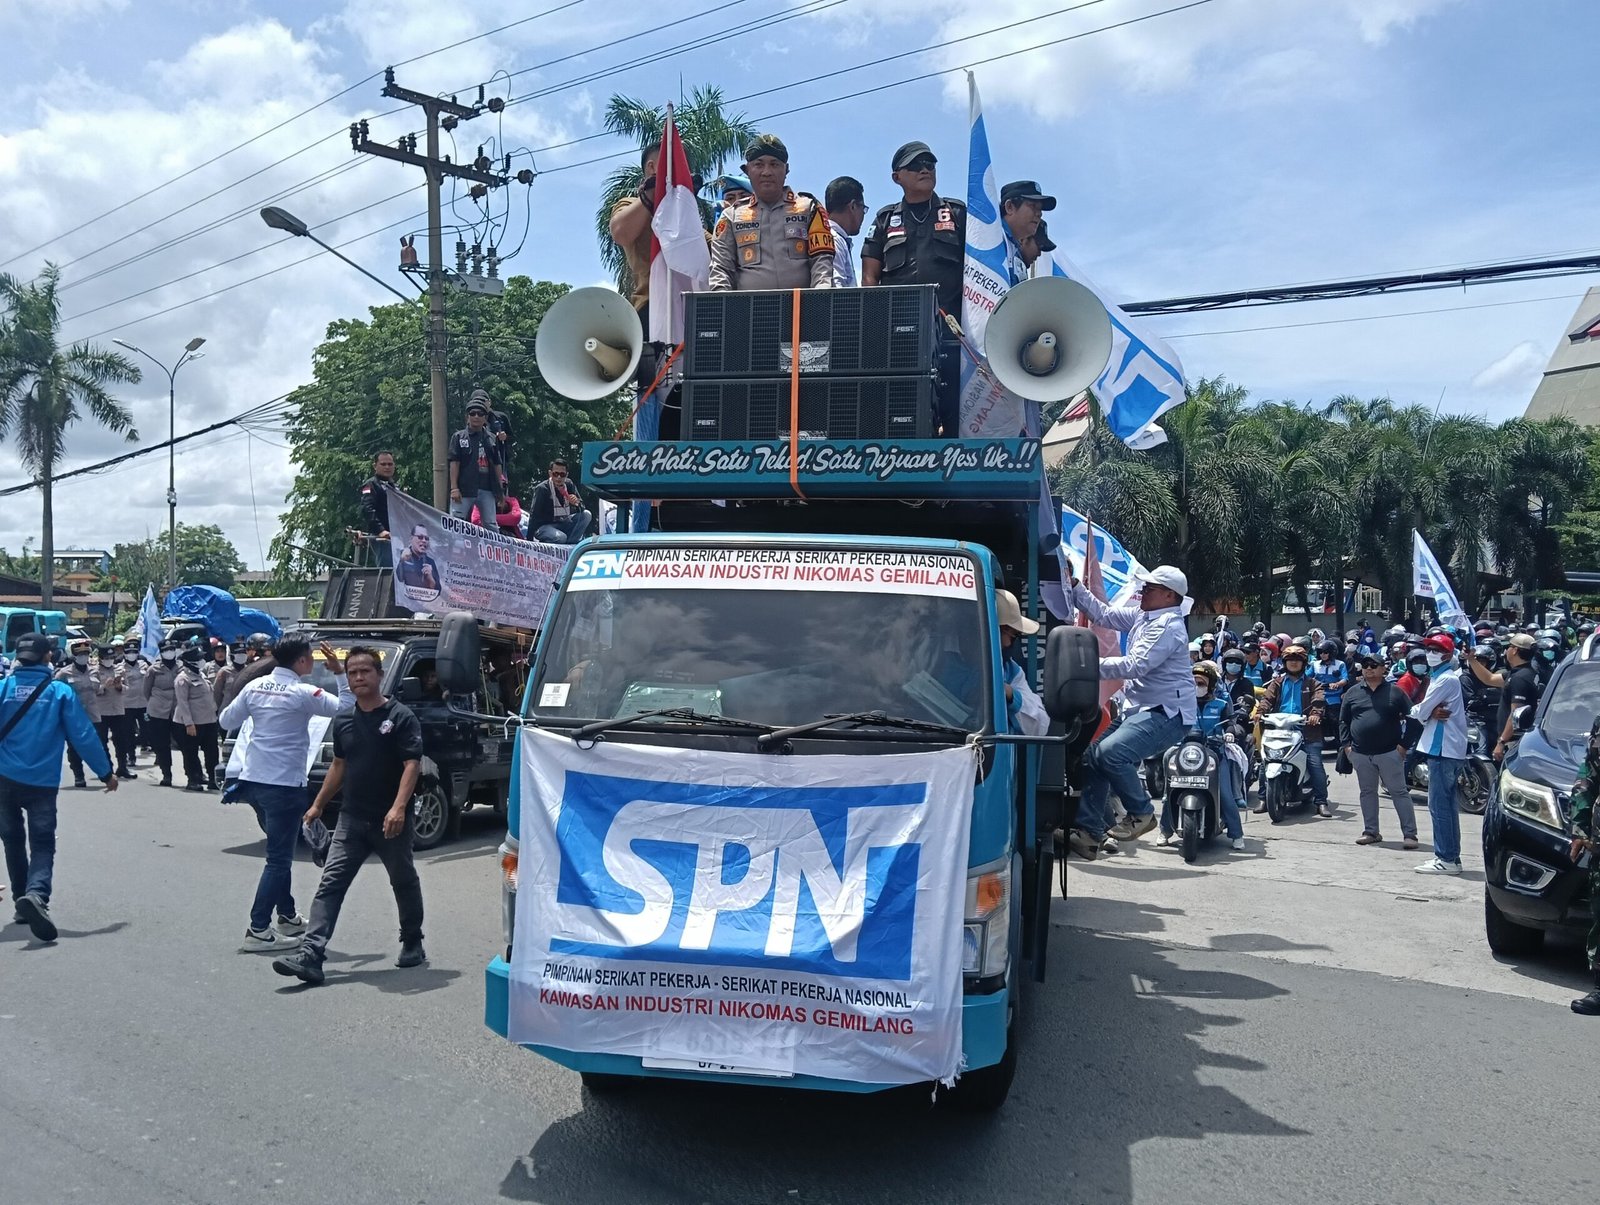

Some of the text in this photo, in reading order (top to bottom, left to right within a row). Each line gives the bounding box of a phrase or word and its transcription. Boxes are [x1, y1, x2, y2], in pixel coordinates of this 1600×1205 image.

[735, 222, 760, 230] CONDRO
[785, 215, 808, 223] POLRI
[938, 208, 951, 222] 6
[810, 233, 835, 248] KA OP
[593, 446, 648, 475] Satu
[699, 447, 751, 473] Satu
[813, 447, 861, 472] Satu
[866, 446, 940, 478] Tujuan
[943, 446, 978, 478] Yess
[441, 516, 460, 533] DPC
[461, 521, 476, 536] FSB
[479, 543, 510, 565] LONG
[572, 552, 626, 578] SPN
[625, 549, 973, 572] PIMPINAN SERIKAT PEKERJA SERIKAT PEKERJA NASIONAL
[709, 564, 789, 580] INDUSTRI
[793, 565, 875, 582] NIKOMAS
[880, 568, 974, 589] GEMILANG
[556, 800, 922, 963] SPN
[543, 963, 592, 984] PIMPINAN
[595, 969, 646, 987] SERIKAT
[650, 971, 711, 989] PEKERJA
[721, 975, 777, 995] SERIKAT
[781, 980, 843, 1004] PEKERJA
[845, 988, 912, 1009] NASIONAL
[540, 988, 914, 1035] KAWASAN INDUSTRI NIKOMAS GEMILANG
